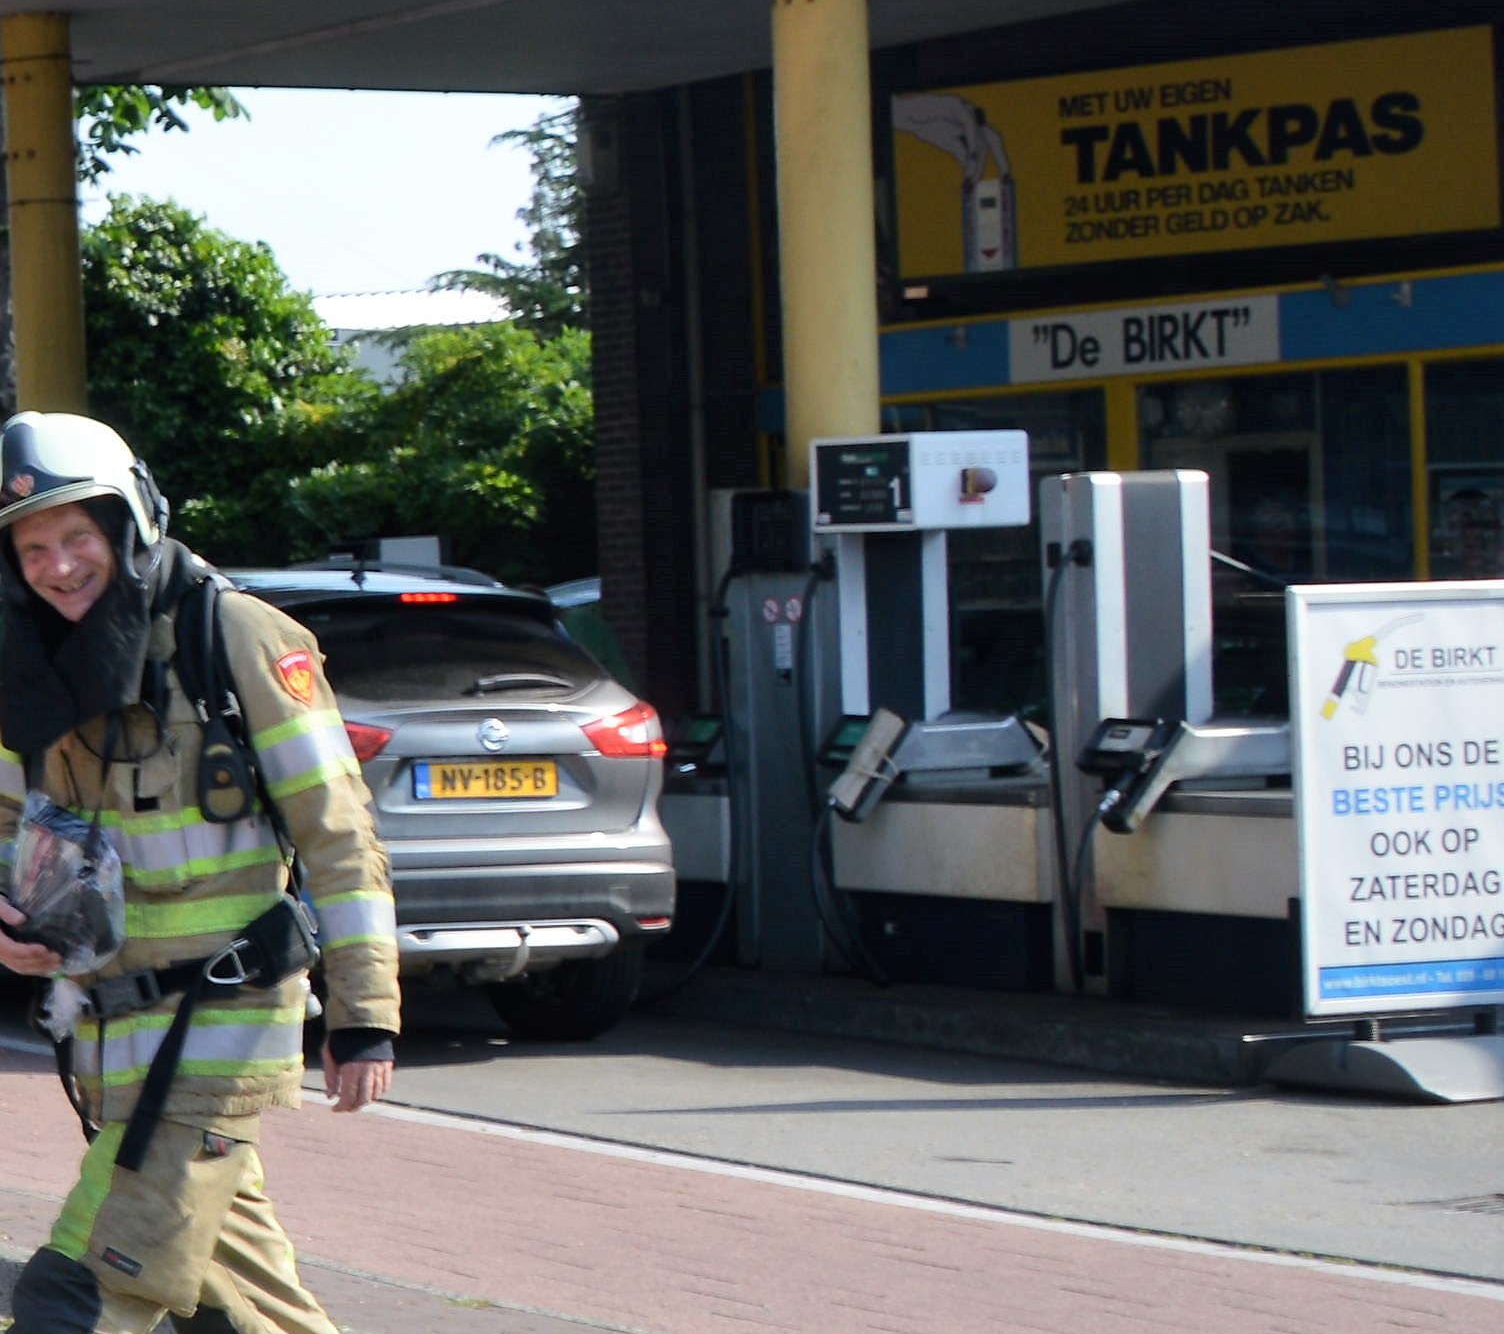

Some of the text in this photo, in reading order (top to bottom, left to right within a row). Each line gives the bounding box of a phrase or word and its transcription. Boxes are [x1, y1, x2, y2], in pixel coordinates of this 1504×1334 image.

[1058, 78, 1232, 119] MET UW EIGEN
[1060, 90, 1426, 185] TANKPAS
[1094, 189, 1142, 214] UUR
[1146, 181, 1193, 209] PER
[1199, 177, 1249, 206] DAG
[1255, 168, 1355, 198] TANKEN
[1064, 199, 1330, 246] ZONDER GELD OP ZAK.
[1394, 646, 1497, 669] DE BIRKT
[1343, 739, 1500, 771] BIJ ONS DE
[441, 766, 547, 792] NV-185-B
[1332, 785, 1425, 816] BESTE
[1370, 827, 1480, 857] OOK OP
[1349, 870, 1501, 902] ZATERDAG
[1344, 912, 1504, 947] EN ZONDAG
